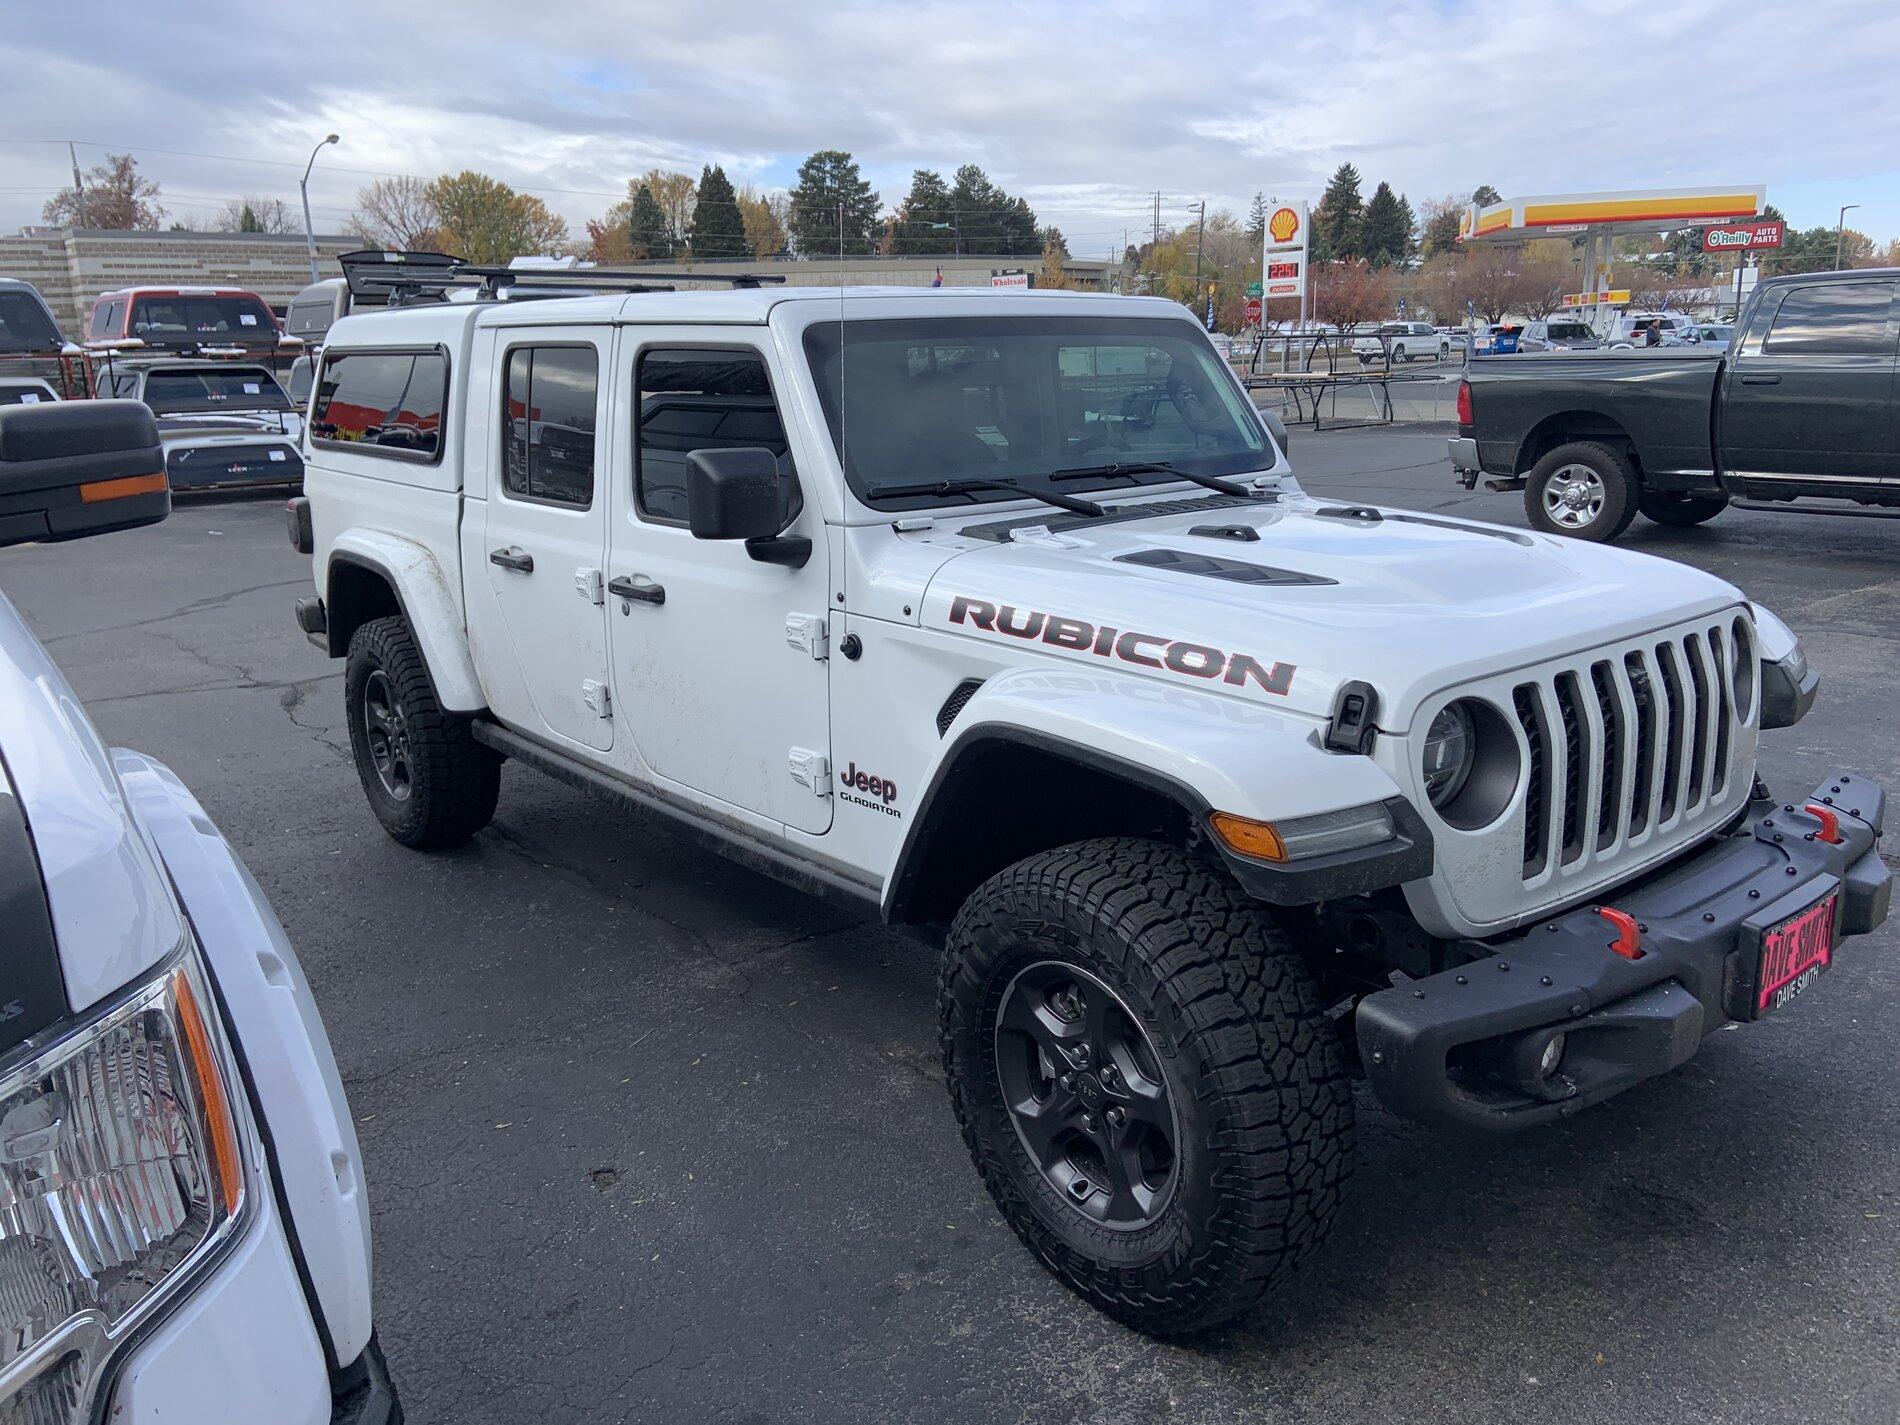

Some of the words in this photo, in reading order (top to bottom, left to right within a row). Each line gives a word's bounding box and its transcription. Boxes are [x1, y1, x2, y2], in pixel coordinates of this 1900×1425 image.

[1708, 230, 1753, 246] O'Reilly
[1753, 234, 1778, 244] PARTS
[1756, 227, 1777, 236] AUTO
[992, 277, 1027, 287] Wholesale
[1247, 307, 1261, 316] STOP
[948, 595, 1297, 697] RUBICON
[840, 761, 897, 805] Jeep
[840, 791, 902, 819] GLADIATOR
[1776, 981, 1796, 1009] DAVE
[1797, 964, 1820, 996] SMITH
